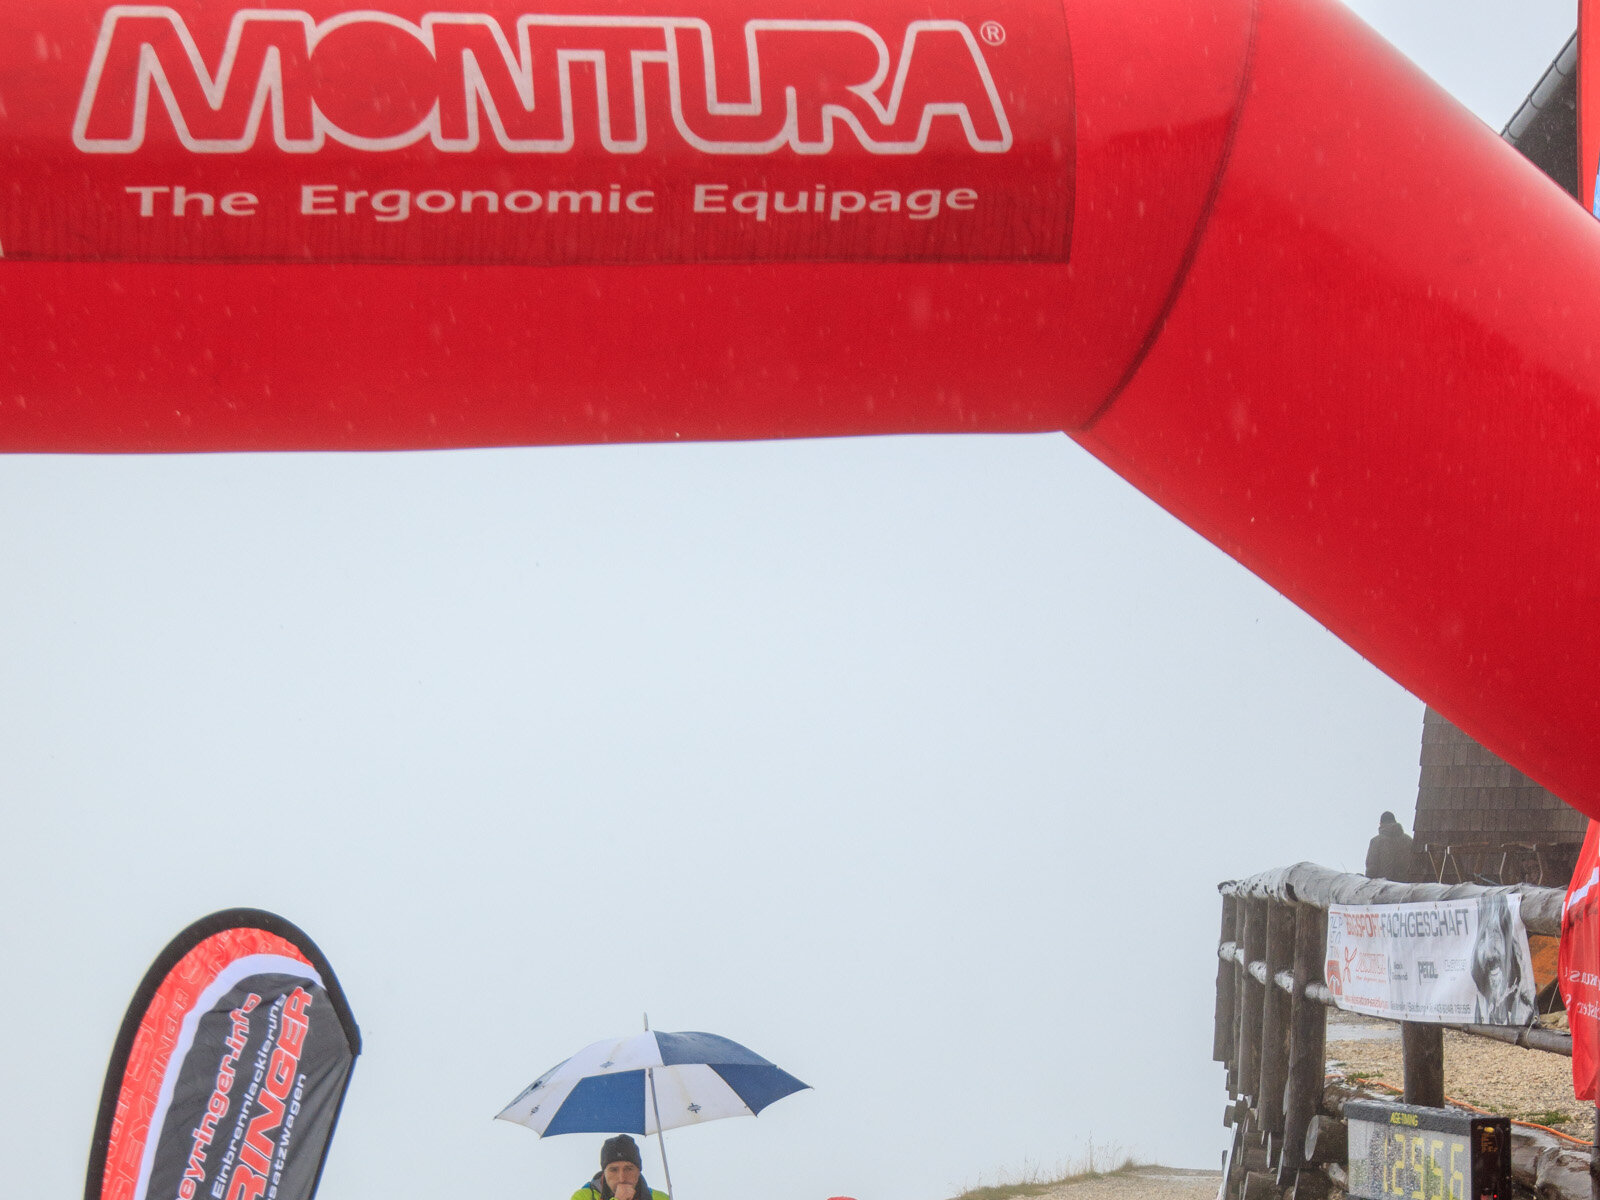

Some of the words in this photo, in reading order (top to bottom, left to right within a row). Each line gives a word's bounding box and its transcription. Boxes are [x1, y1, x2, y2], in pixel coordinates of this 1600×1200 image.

[125, 184, 259, 218] The
[299, 184, 655, 222] Ergonomic
[692, 183, 979, 222] Equipage
